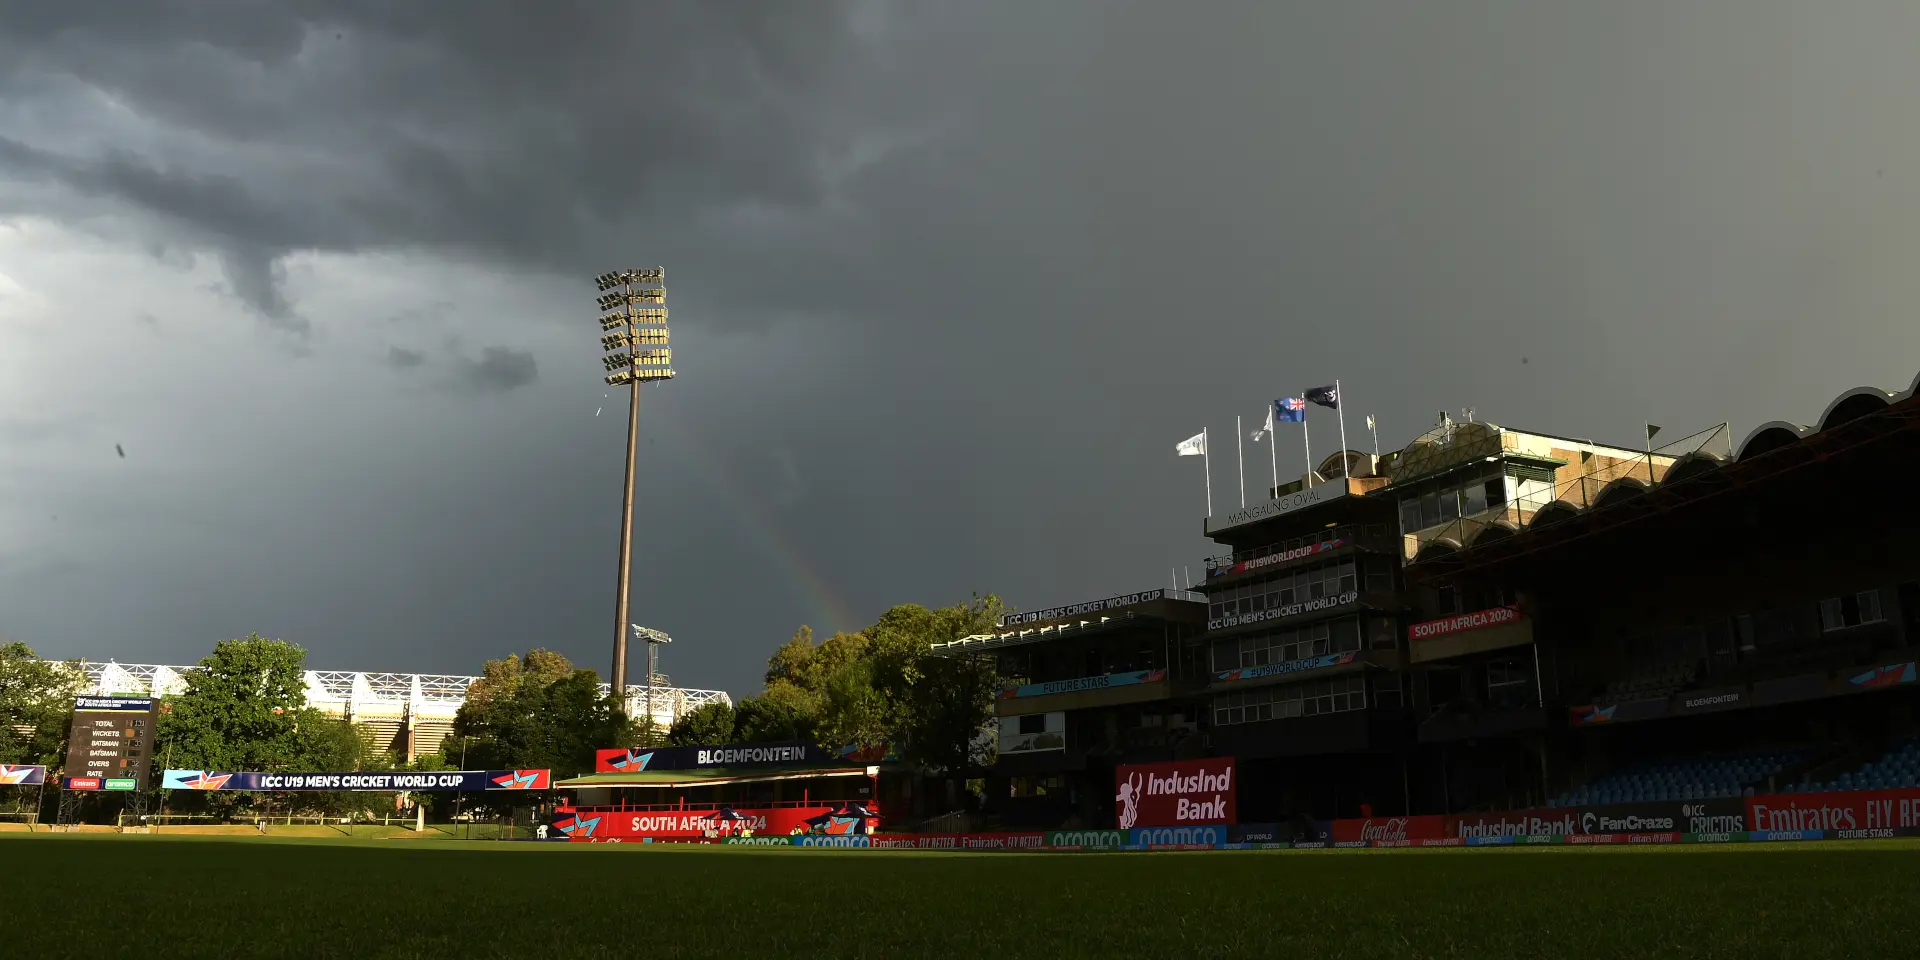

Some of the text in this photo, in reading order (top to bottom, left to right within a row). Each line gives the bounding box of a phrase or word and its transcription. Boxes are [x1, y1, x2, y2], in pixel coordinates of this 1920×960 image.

[1228, 490, 1320, 525] MANGAUNG OVAL
[1244, 546, 1312, 570] #U19WORLDCUP
[1007, 590, 1161, 625] ICC U19 MEN'S CRICKET WORLD CUP
[1208, 592, 1358, 630] ICC U19 MEN'S CRICKET WORLD CUP
[1414, 610, 1513, 636] SOUTH AFRICA 2024
[1250, 658, 1320, 676] #U19WORLDCUP
[1043, 676, 1110, 693] FUTURE STARS
[1686, 694, 1738, 708] BLOEMFONTEIN
[698, 746, 805, 764] BLOEMFONTEIN
[261, 775, 464, 788] ICC U19 MEN'S CRICKET WORLD CUP
[1147, 766, 1232, 795] IndusInd
[1176, 794, 1226, 820] Bank
[1692, 804, 1705, 816] ICC
[632, 816, 677, 832] SOUTH
[1600, 816, 1674, 831] FanCraze
[1690, 816, 1744, 833] CRICTOS
[1752, 801, 1856, 831] Emirates
[1459, 814, 1576, 838] IndusInd Bank
[1838, 828, 1894, 839] FUTURE STARS
[873, 838, 915, 848] Emirates
[962, 837, 1004, 848] Emirates
[1053, 831, 1121, 846] aramco
[1139, 828, 1217, 845] aramco
[1698, 833, 1730, 842] aramco
[1768, 832, 1802, 840] aramco
